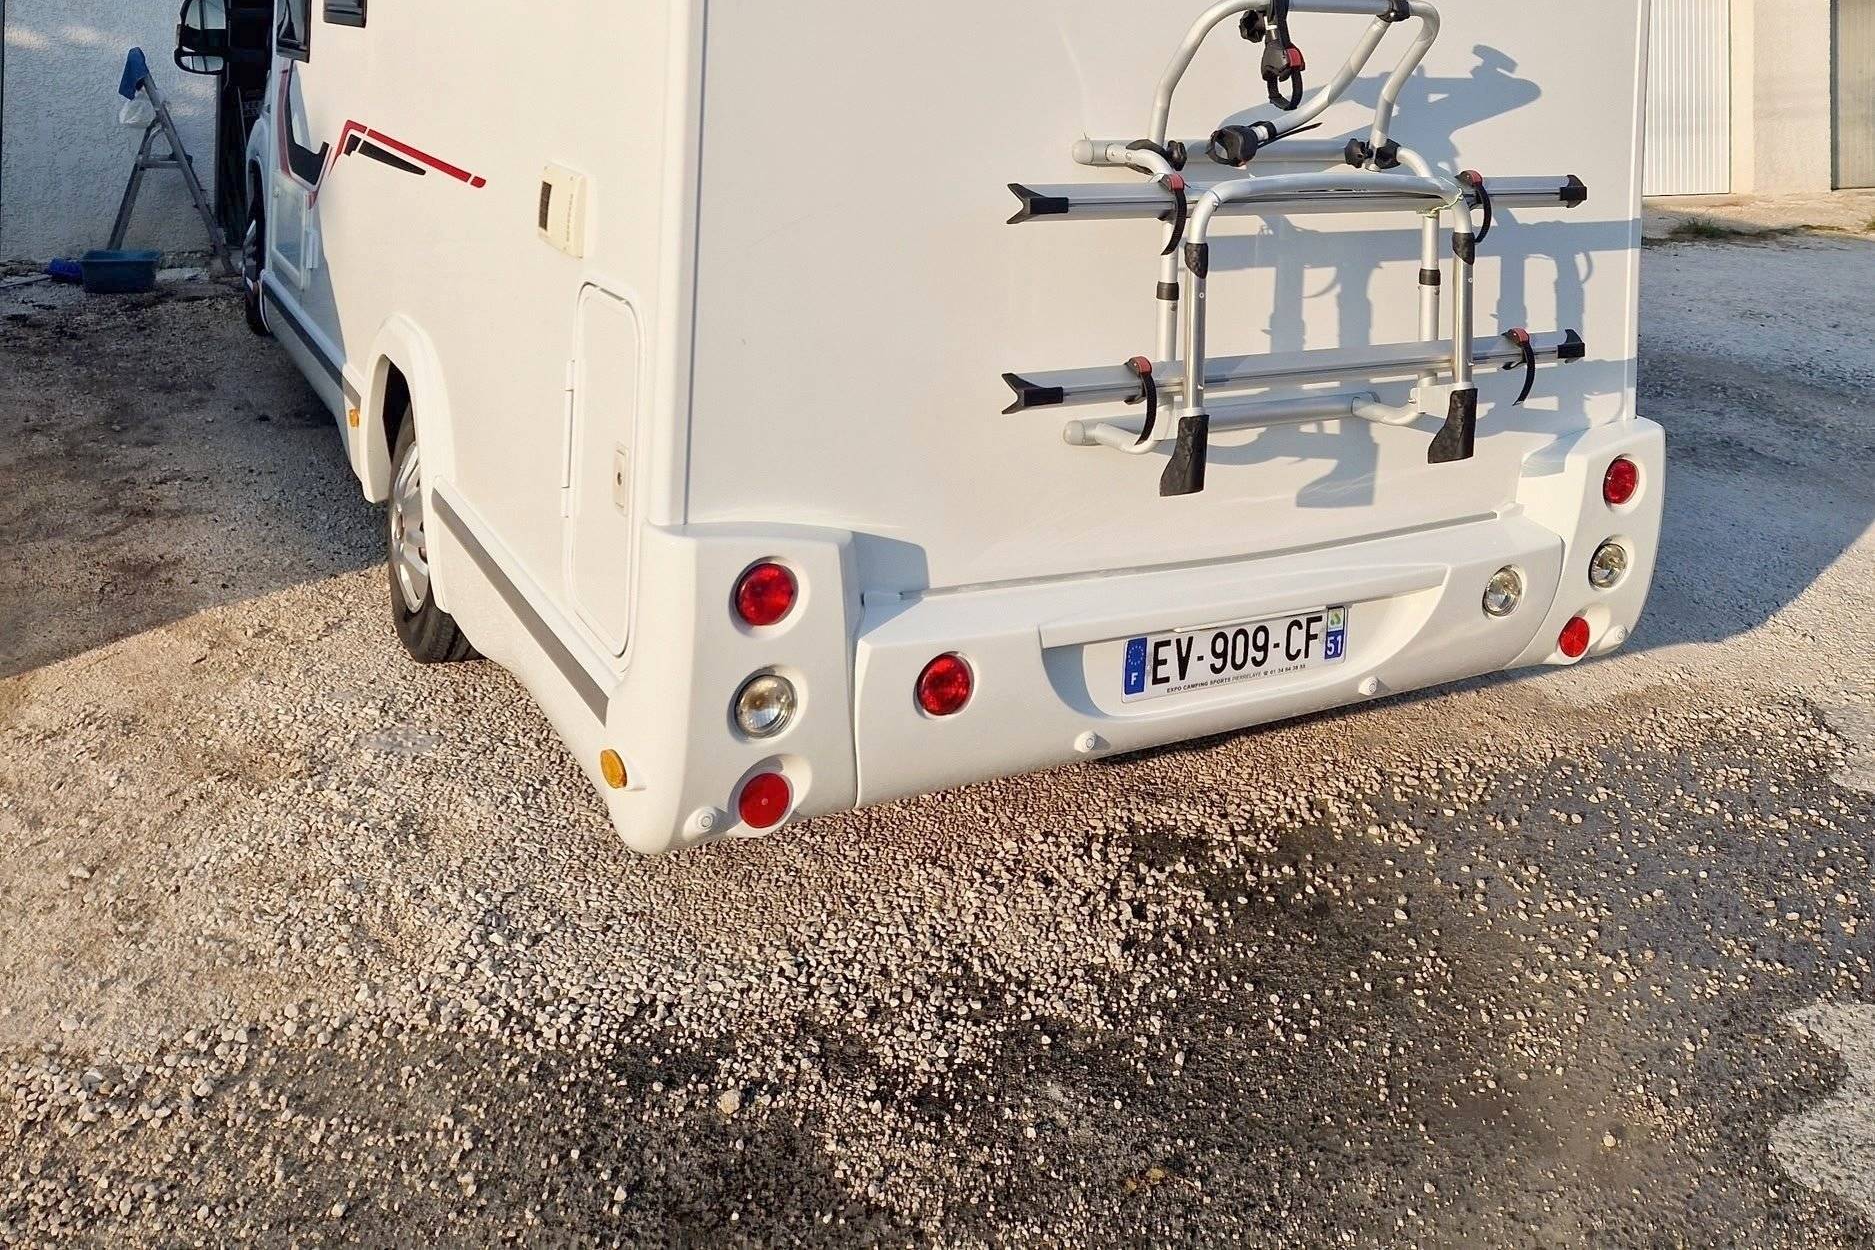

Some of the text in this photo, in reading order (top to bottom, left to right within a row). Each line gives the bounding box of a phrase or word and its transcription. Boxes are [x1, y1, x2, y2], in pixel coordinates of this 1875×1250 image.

[1152, 615, 1323, 686] EV-909-CF
[1326, 635, 1342, 656] 51
[1130, 672, 1137, 685] F
[1166, 686, 1182, 694] EXPO
[1183, 681, 1209, 690] CAMPING
[1210, 677, 1230, 685] SPORTS
